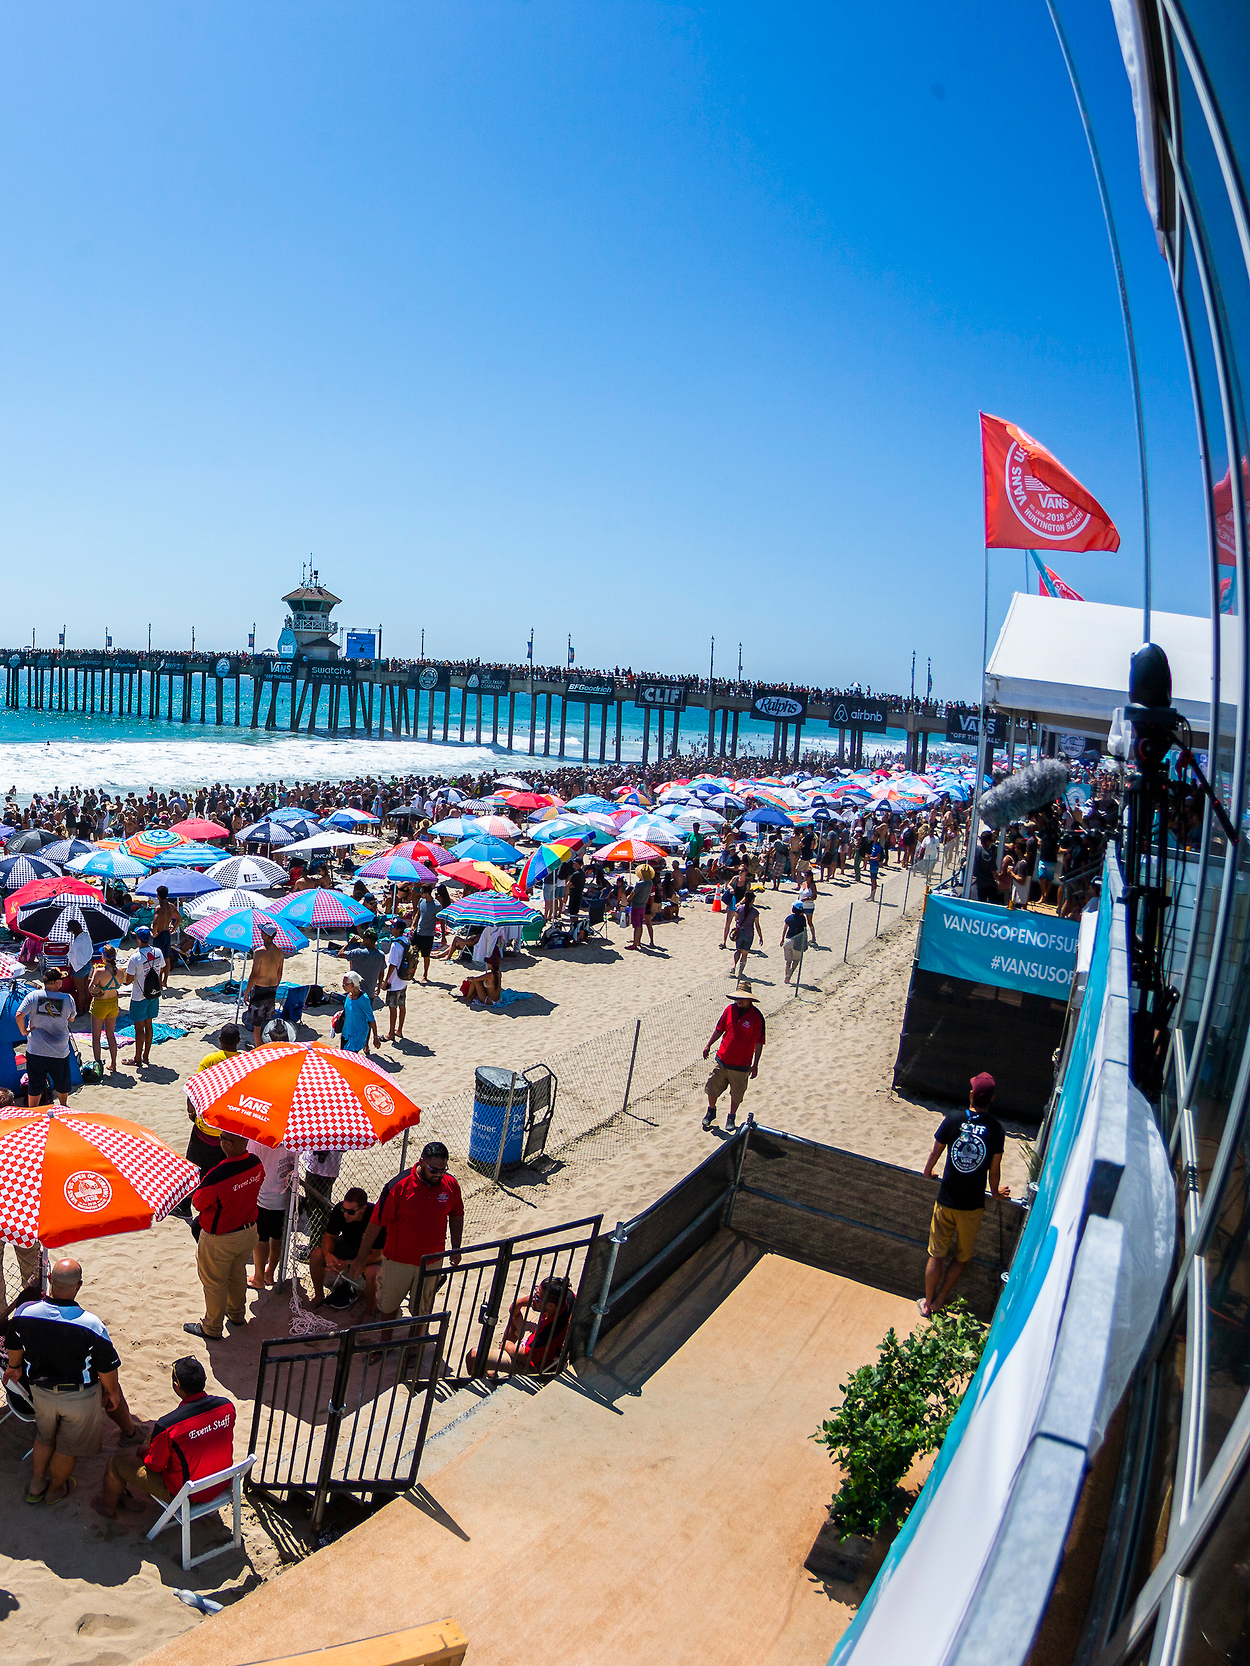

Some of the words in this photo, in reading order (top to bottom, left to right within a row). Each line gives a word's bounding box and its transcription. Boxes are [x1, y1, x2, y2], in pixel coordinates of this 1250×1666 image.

[1011, 466, 1027, 507] VANS
[1038, 493, 1069, 509] VANS
[1024, 508, 1065, 532] HUNTINGTON
[1066, 510, 1084, 530] BEACH
[1046, 512, 1065, 522] 2018
[270, 661, 293, 673] VANS
[568, 683, 612, 693] BFGoodrich
[644, 687, 680, 704] CLIF
[759, 698, 798, 715] Ralphs
[850, 709, 883, 722] airbnb
[950, 732, 966, 740] "OFF
[239, 1094, 272, 1115] VANS
[227, 1104, 241, 1112] "OFF
[241, 1109, 252, 1117] THE
[252, 1112, 270, 1123] WALL"
[232, 1179, 249, 1191] Event
[250, 1170, 262, 1184] Staff
[188, 1424, 212, 1440] Event
[213, 1413, 231, 1431] Staff
